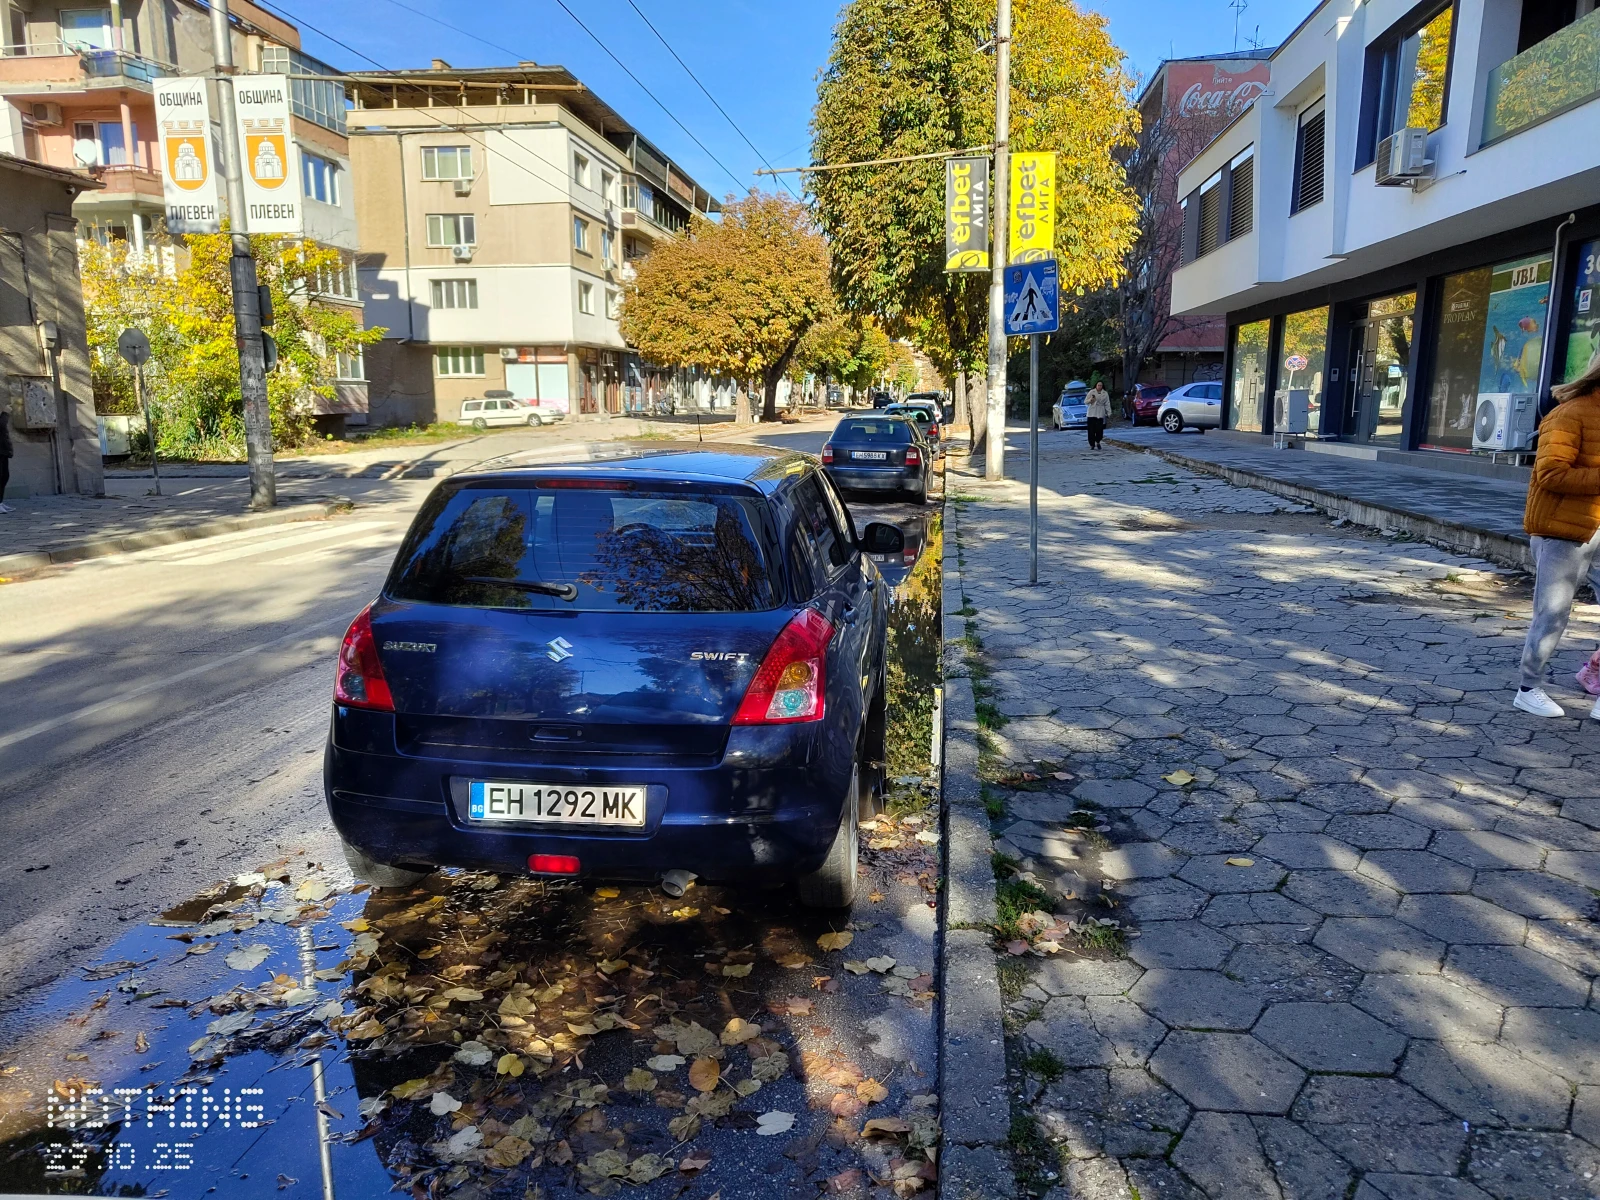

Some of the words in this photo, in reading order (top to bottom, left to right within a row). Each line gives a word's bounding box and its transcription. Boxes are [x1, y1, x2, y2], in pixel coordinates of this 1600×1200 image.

[159, 91, 203, 107] ОБЩИНА
[238, 89, 283, 105] ОБЩИНА
[973, 181, 984, 228] ЛИГА
[1039, 178, 1050, 224] ЛИГА
[170, 205, 215, 220] ПЛЕВЕН
[250, 204, 295, 219] ПЛЕВЕН
[1512, 266, 1536, 287] JBL
[382, 641, 437, 653] SUZUKI
[690, 651, 750, 661] SWIFT
[472, 804, 483, 813] BG
[489, 788, 524, 815] EH
[533, 789, 596, 818] 1292
[602, 791, 637, 819] MK
